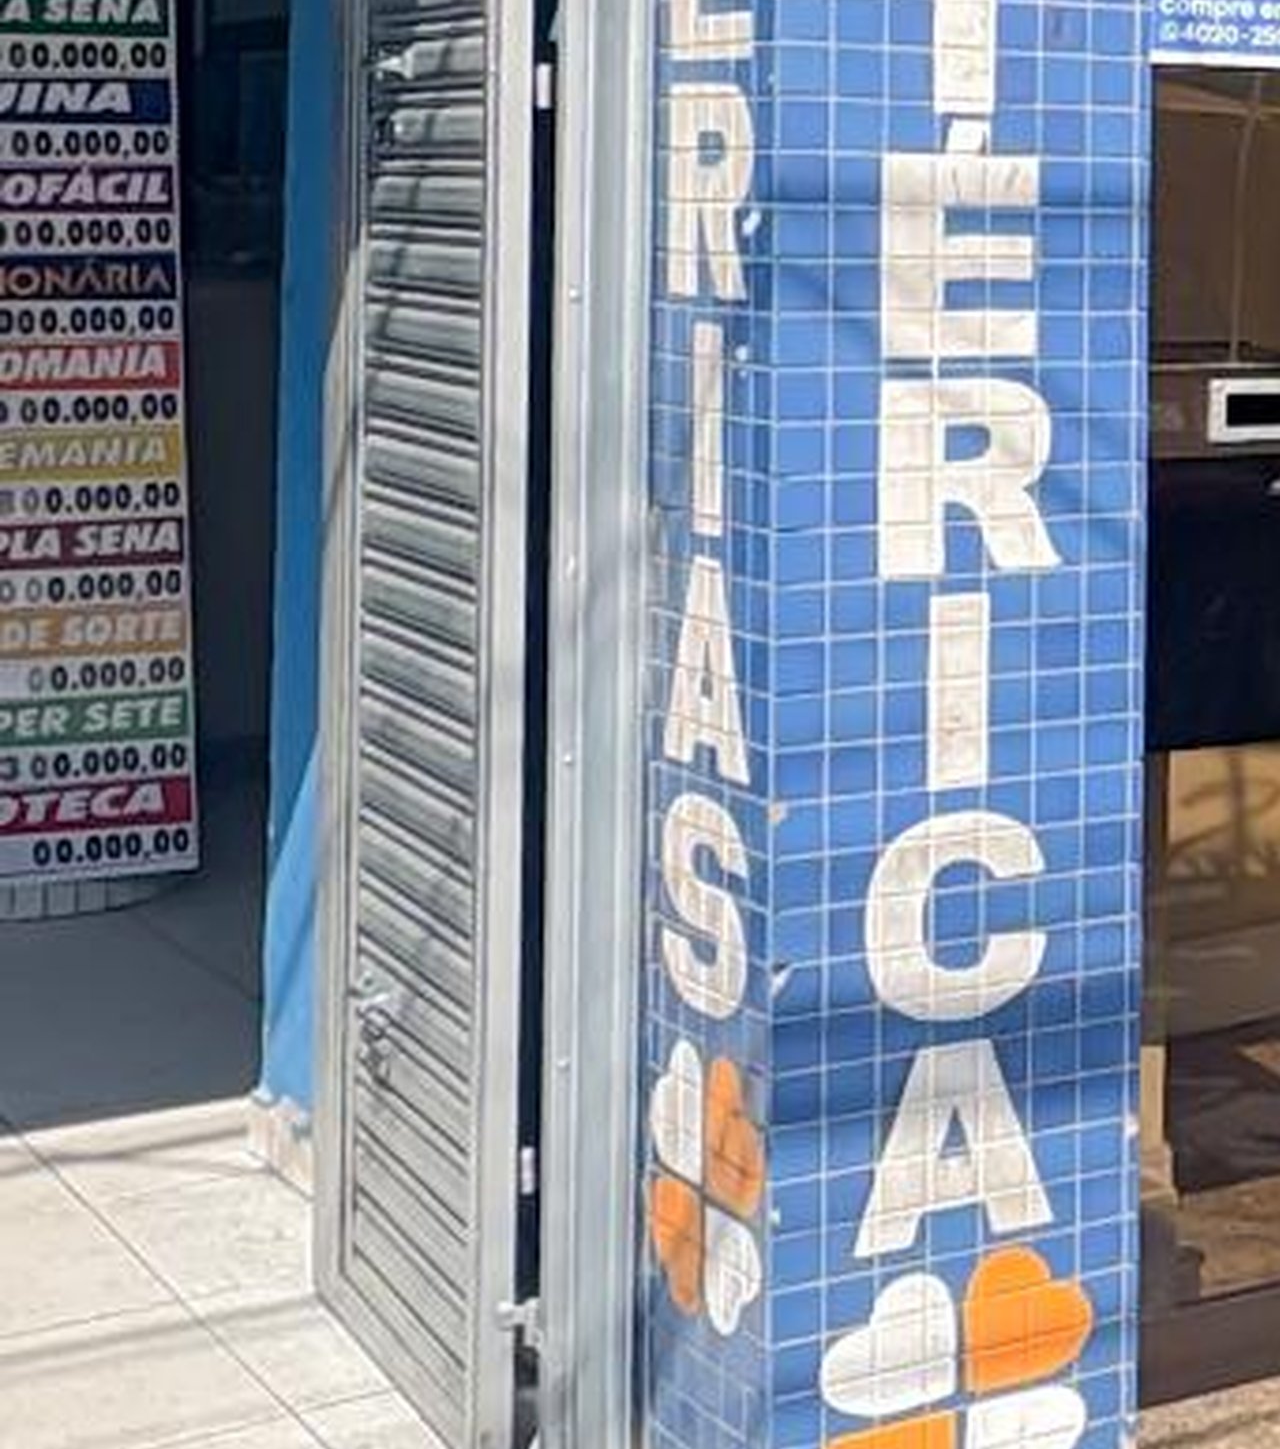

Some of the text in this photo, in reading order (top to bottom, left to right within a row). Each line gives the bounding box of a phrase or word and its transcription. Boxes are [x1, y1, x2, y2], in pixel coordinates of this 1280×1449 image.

[73, 519, 181, 556] SENA
[60, 611, 181, 647] SORTE
[82, 697, 181, 734] SETE
